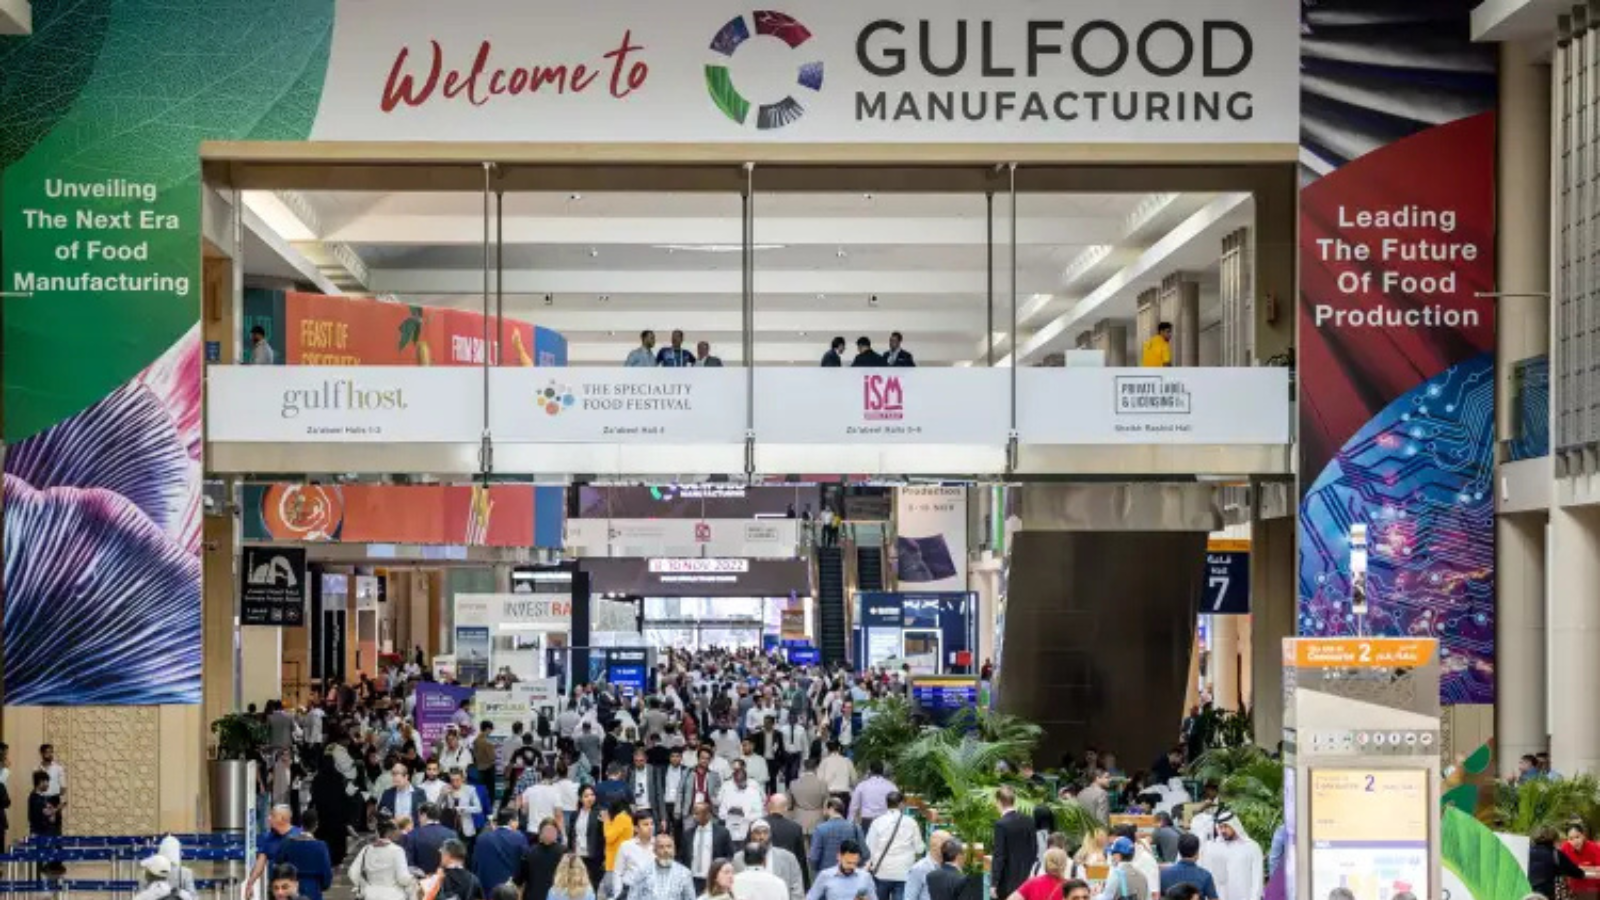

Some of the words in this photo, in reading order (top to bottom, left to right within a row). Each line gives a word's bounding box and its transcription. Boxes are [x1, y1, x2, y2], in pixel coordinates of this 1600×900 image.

[856, 19, 1253, 77] GULFOOD
[381, 40, 599, 112] Welcome
[603, 29, 648, 98] to
[855, 91, 1253, 121] MANUFACTURING
[45, 178, 157, 202] Unveiling
[23, 209, 67, 229] The
[76, 210, 131, 229] Next
[140, 210, 180, 229] Era
[1338, 205, 1456, 232] Leading
[55, 241, 79, 260] of
[87, 241, 148, 260] Food
[1316, 238, 1370, 261] The
[1381, 238, 1478, 261] Future
[13, 272, 190, 296] Manufacturing
[1337, 271, 1371, 294] Of
[1382, 271, 1456, 294] Food
[1315, 304, 1479, 327] Production
[300, 319, 332, 348] FEAST
[584, 384, 609, 395] THE
[614, 384, 693, 395] SPECIALITY
[584, 399, 622, 410] FOOD
[627, 399, 693, 410] FESTIVAL
[1209, 576, 1229, 610] 7
[1359, 644, 1371, 662] 2
[1365, 775, 1375, 792] 2
